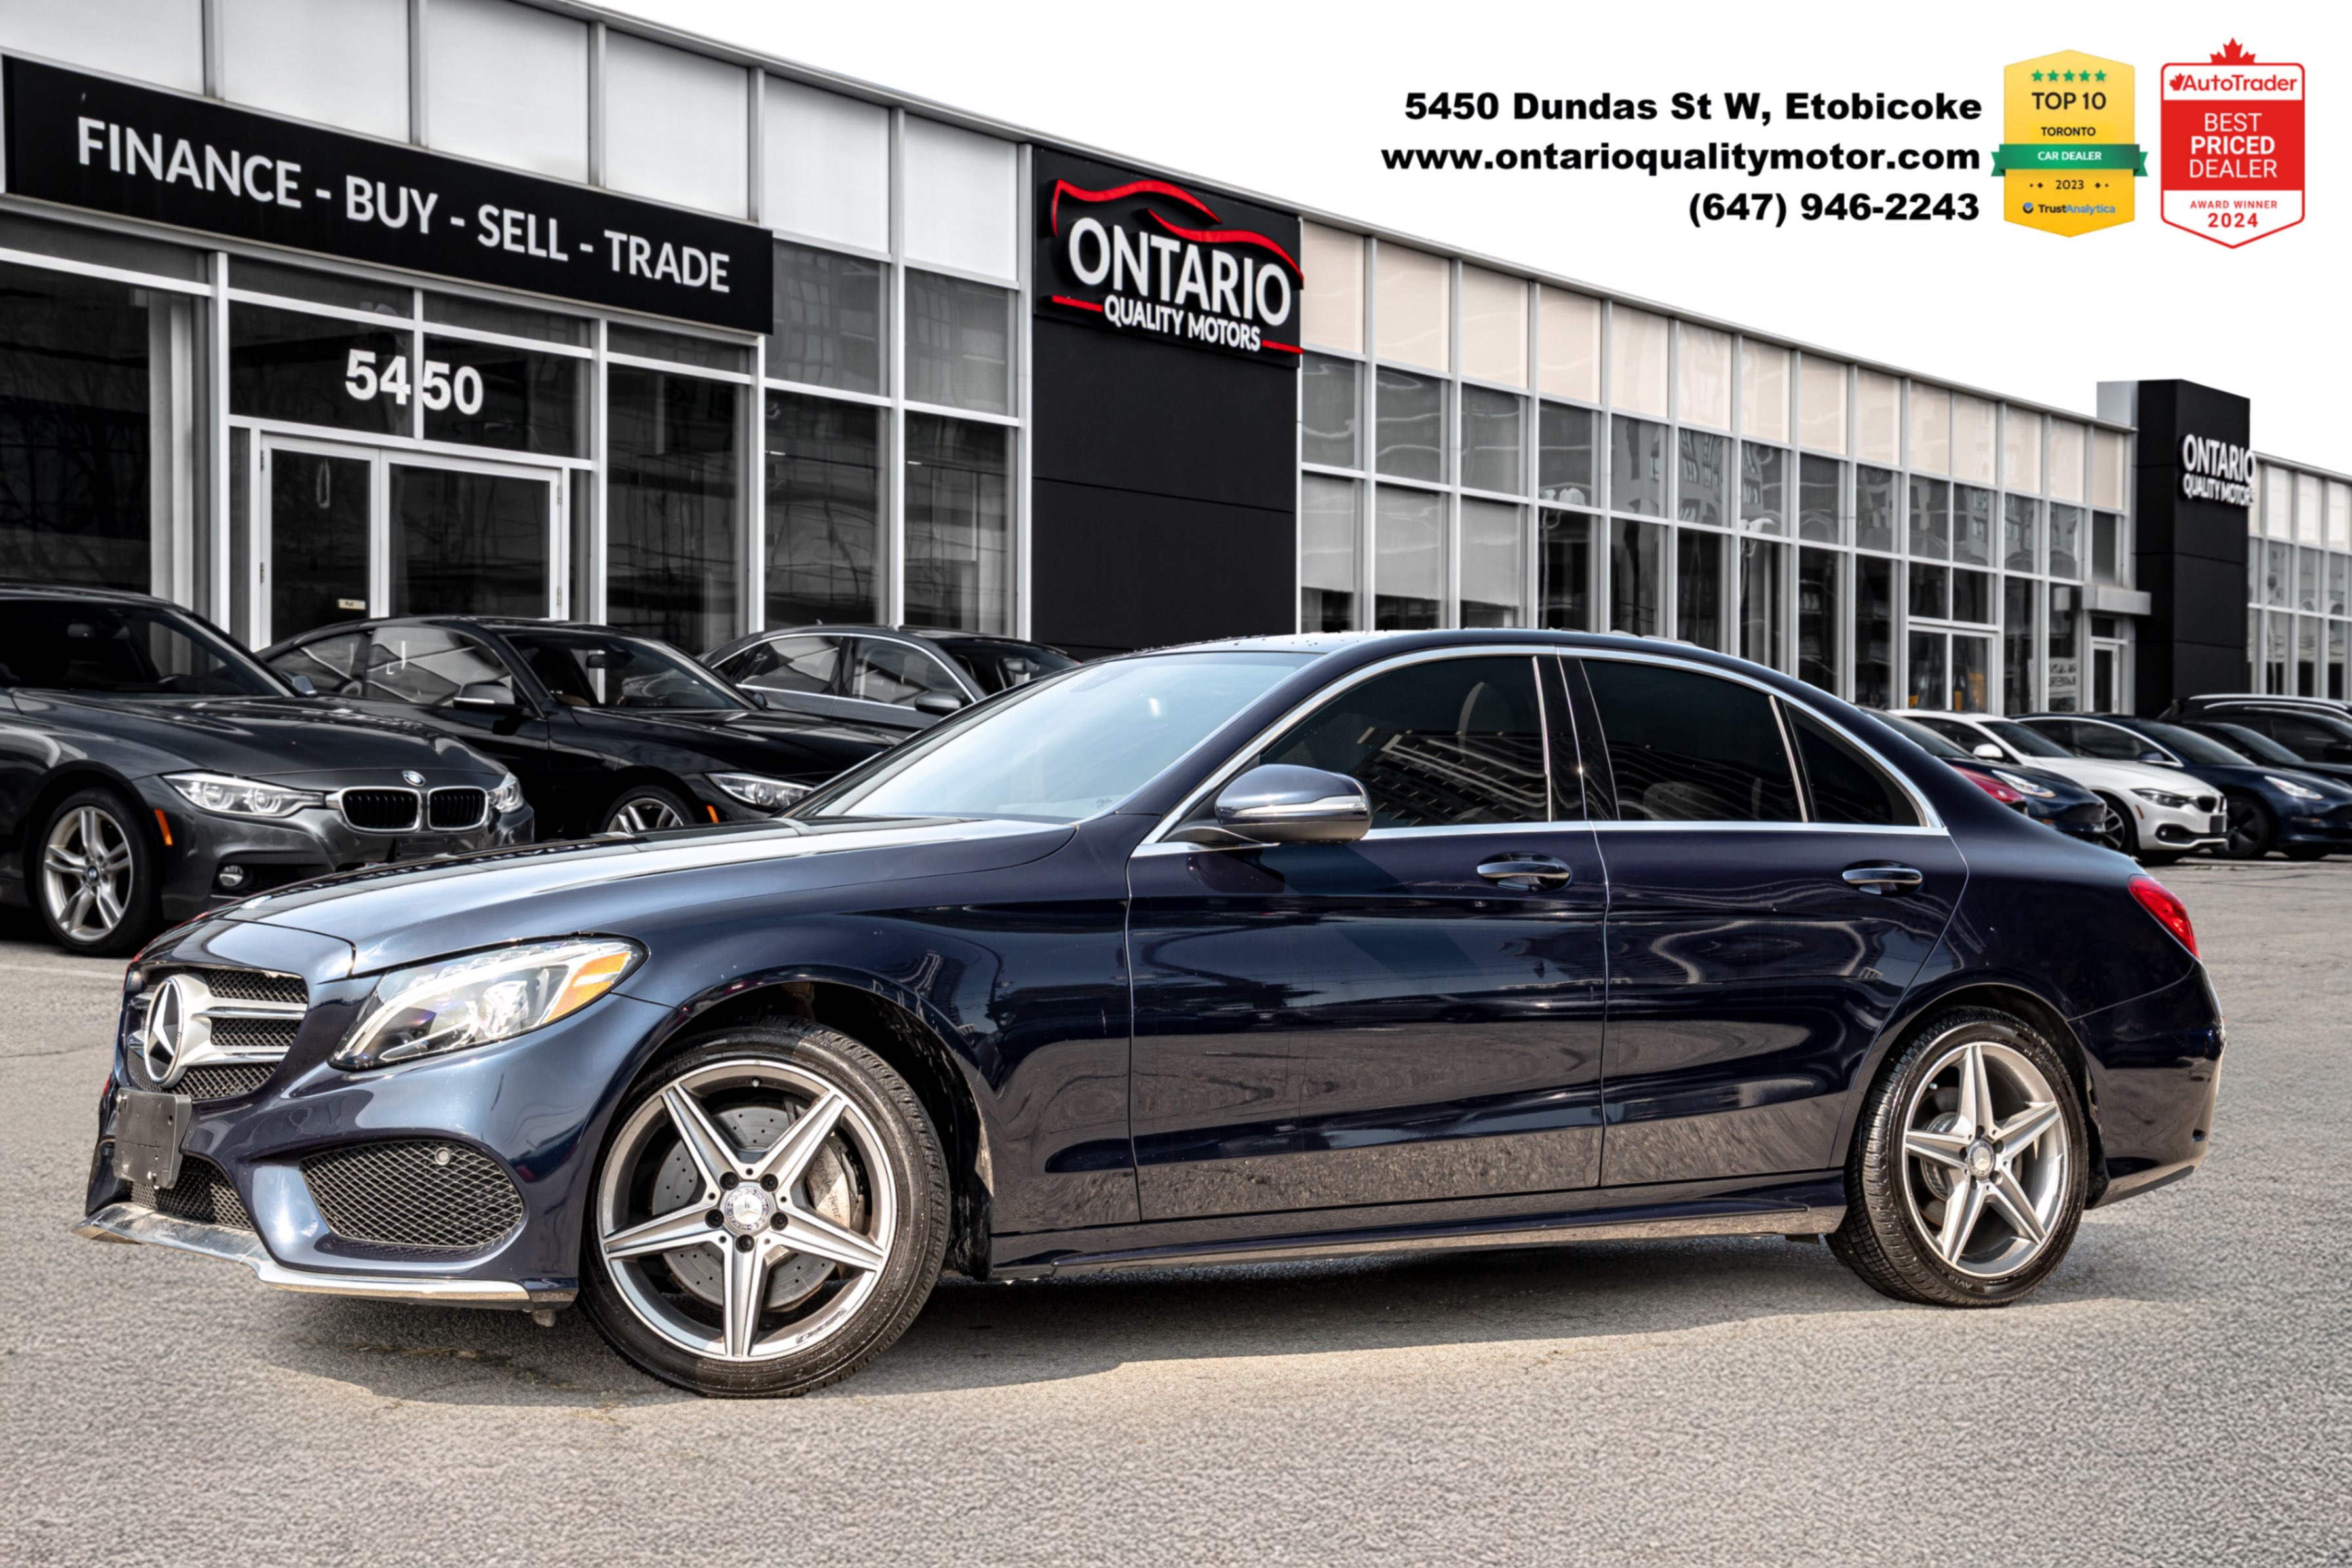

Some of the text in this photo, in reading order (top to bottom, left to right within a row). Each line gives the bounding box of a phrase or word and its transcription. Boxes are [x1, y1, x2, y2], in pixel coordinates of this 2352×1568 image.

[78, 116, 301, 208] FINANCE
[346, 175, 438, 234] BUY
[478, 204, 568, 261] SELL
[604, 229, 730, 293] TRADE
[1069, 217, 1291, 326] ONTARIO
[1104, 294, 1261, 352] QUALITY MOTORS
[345, 349, 484, 415] 5450
[2182, 433, 2256, 485] ONTARIO
[2182, 472, 2220, 500] QUALITY
